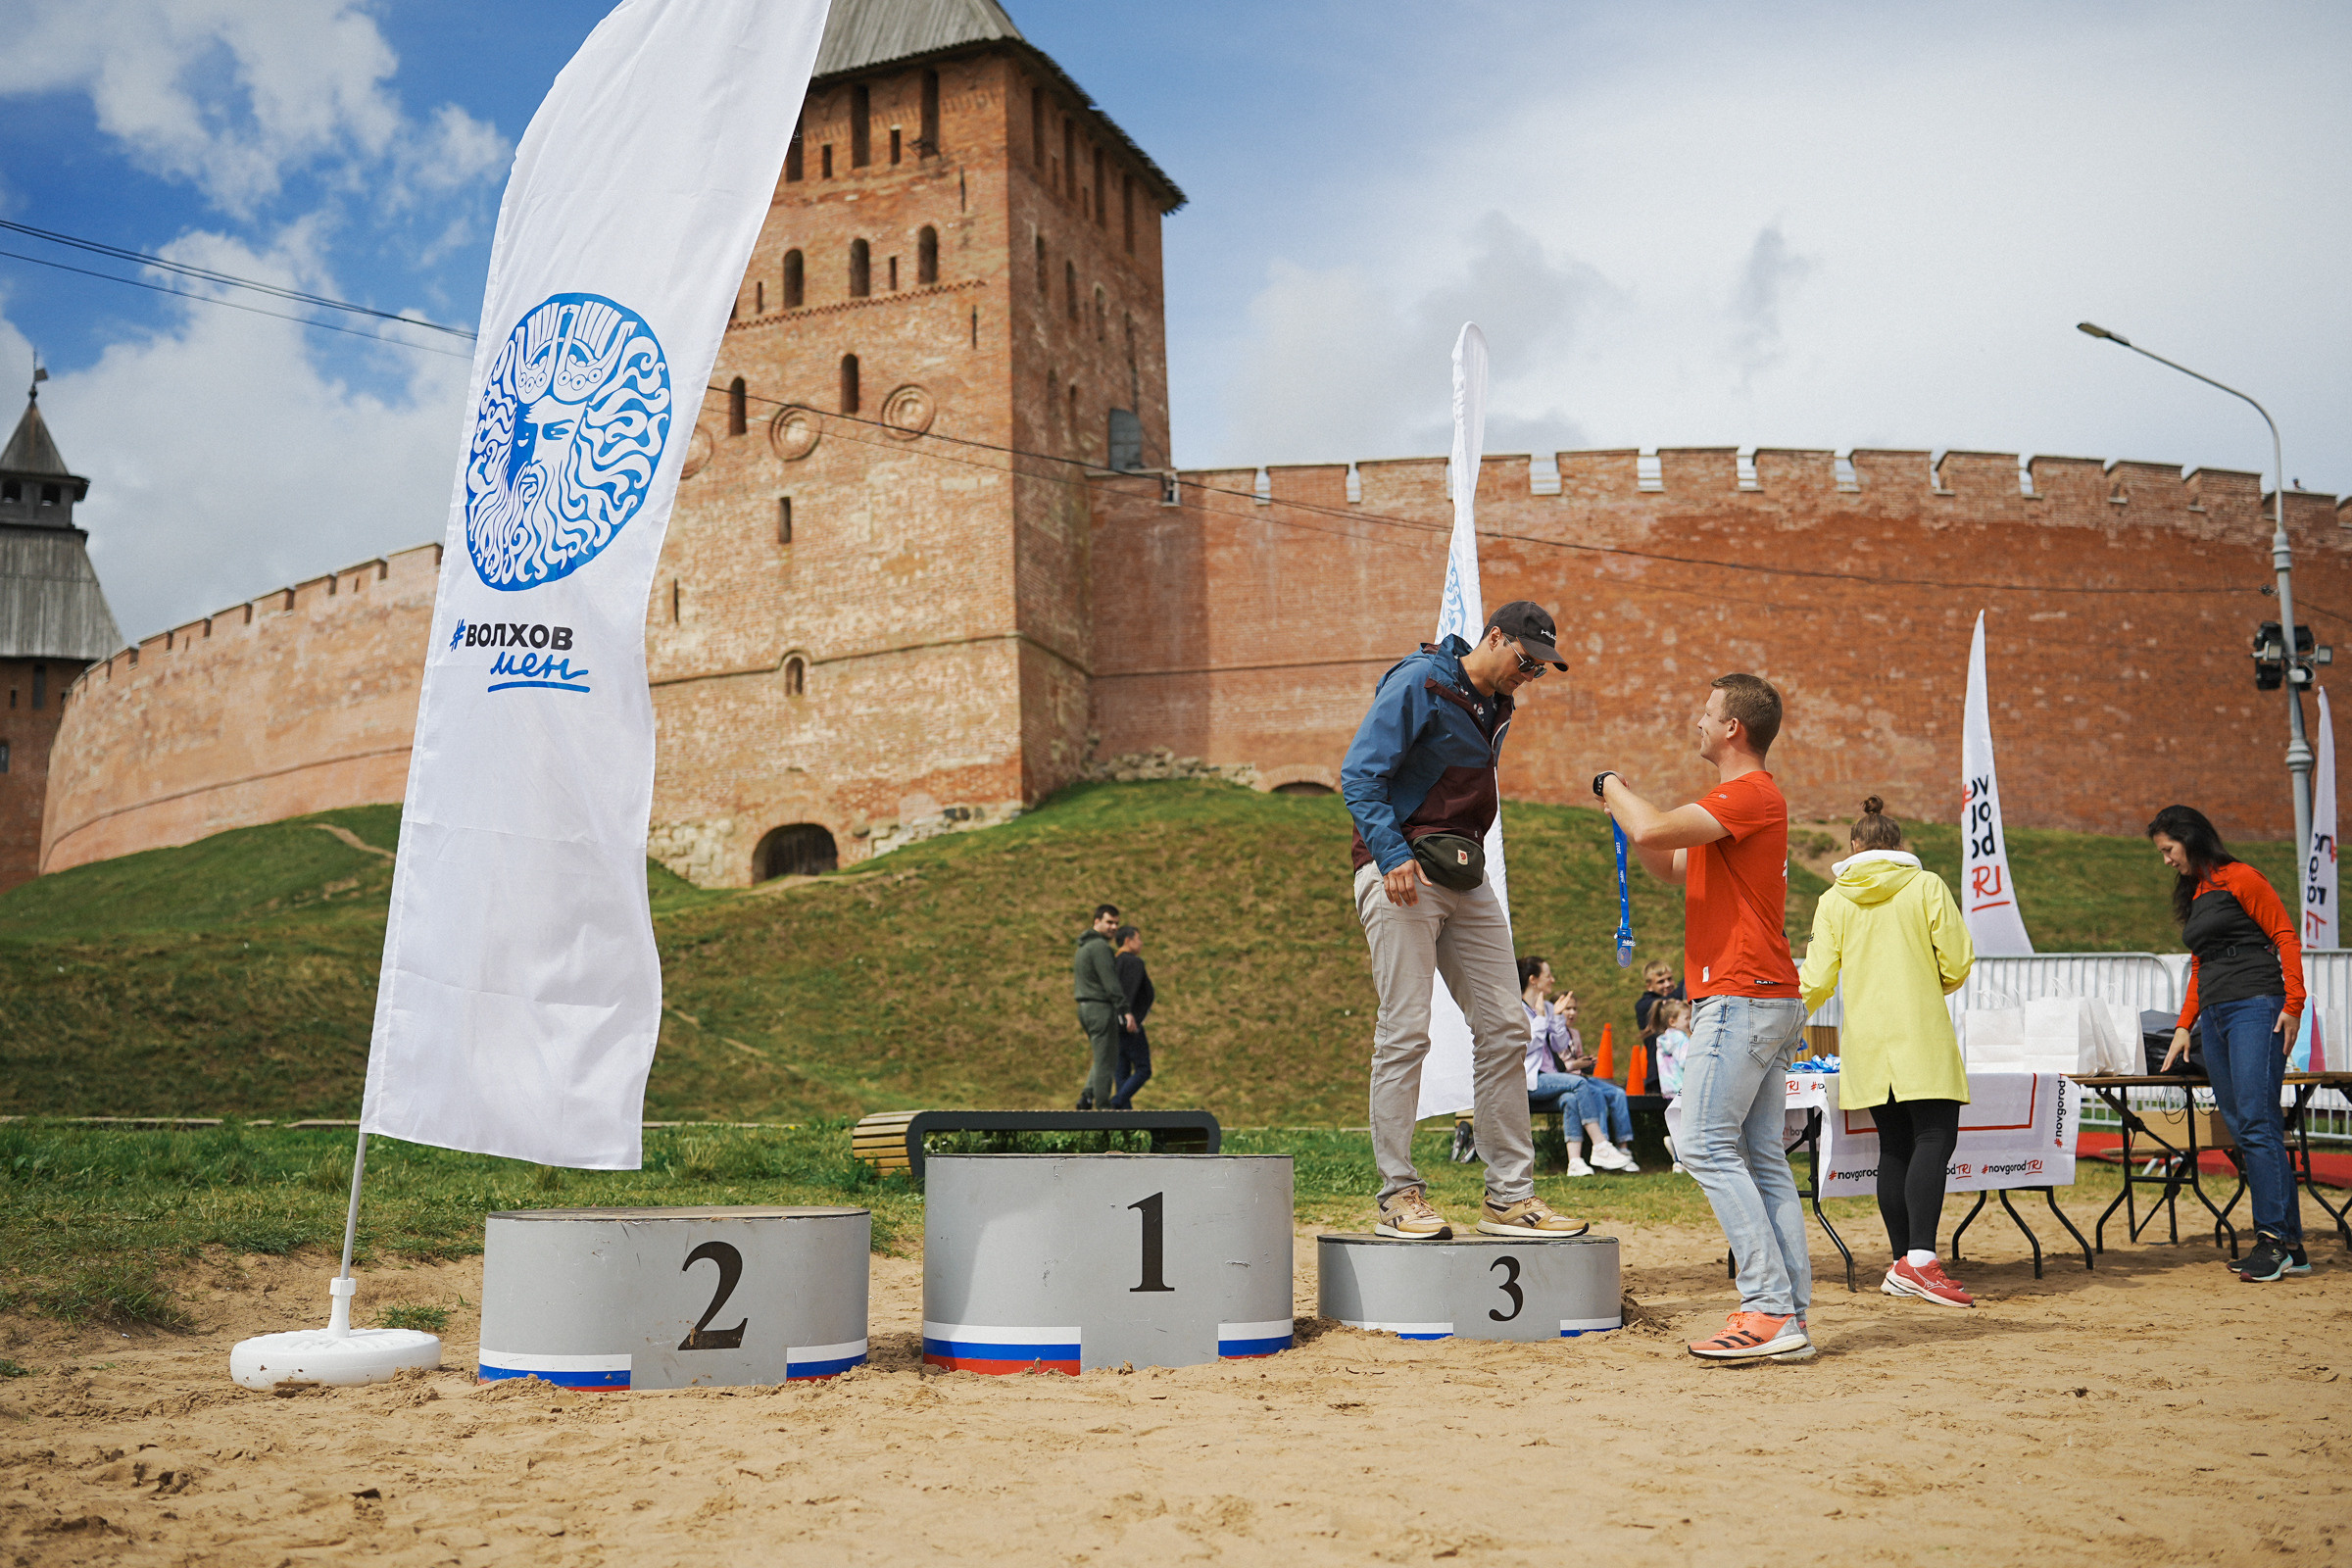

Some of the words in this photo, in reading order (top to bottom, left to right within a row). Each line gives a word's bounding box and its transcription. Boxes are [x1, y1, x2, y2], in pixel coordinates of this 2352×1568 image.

[449, 618, 573, 651] #ВОЛХОВ
[1127, 1191, 1175, 1293] 1
[678, 1241, 749, 1350] 2
[1489, 1255, 1524, 1321] 3
